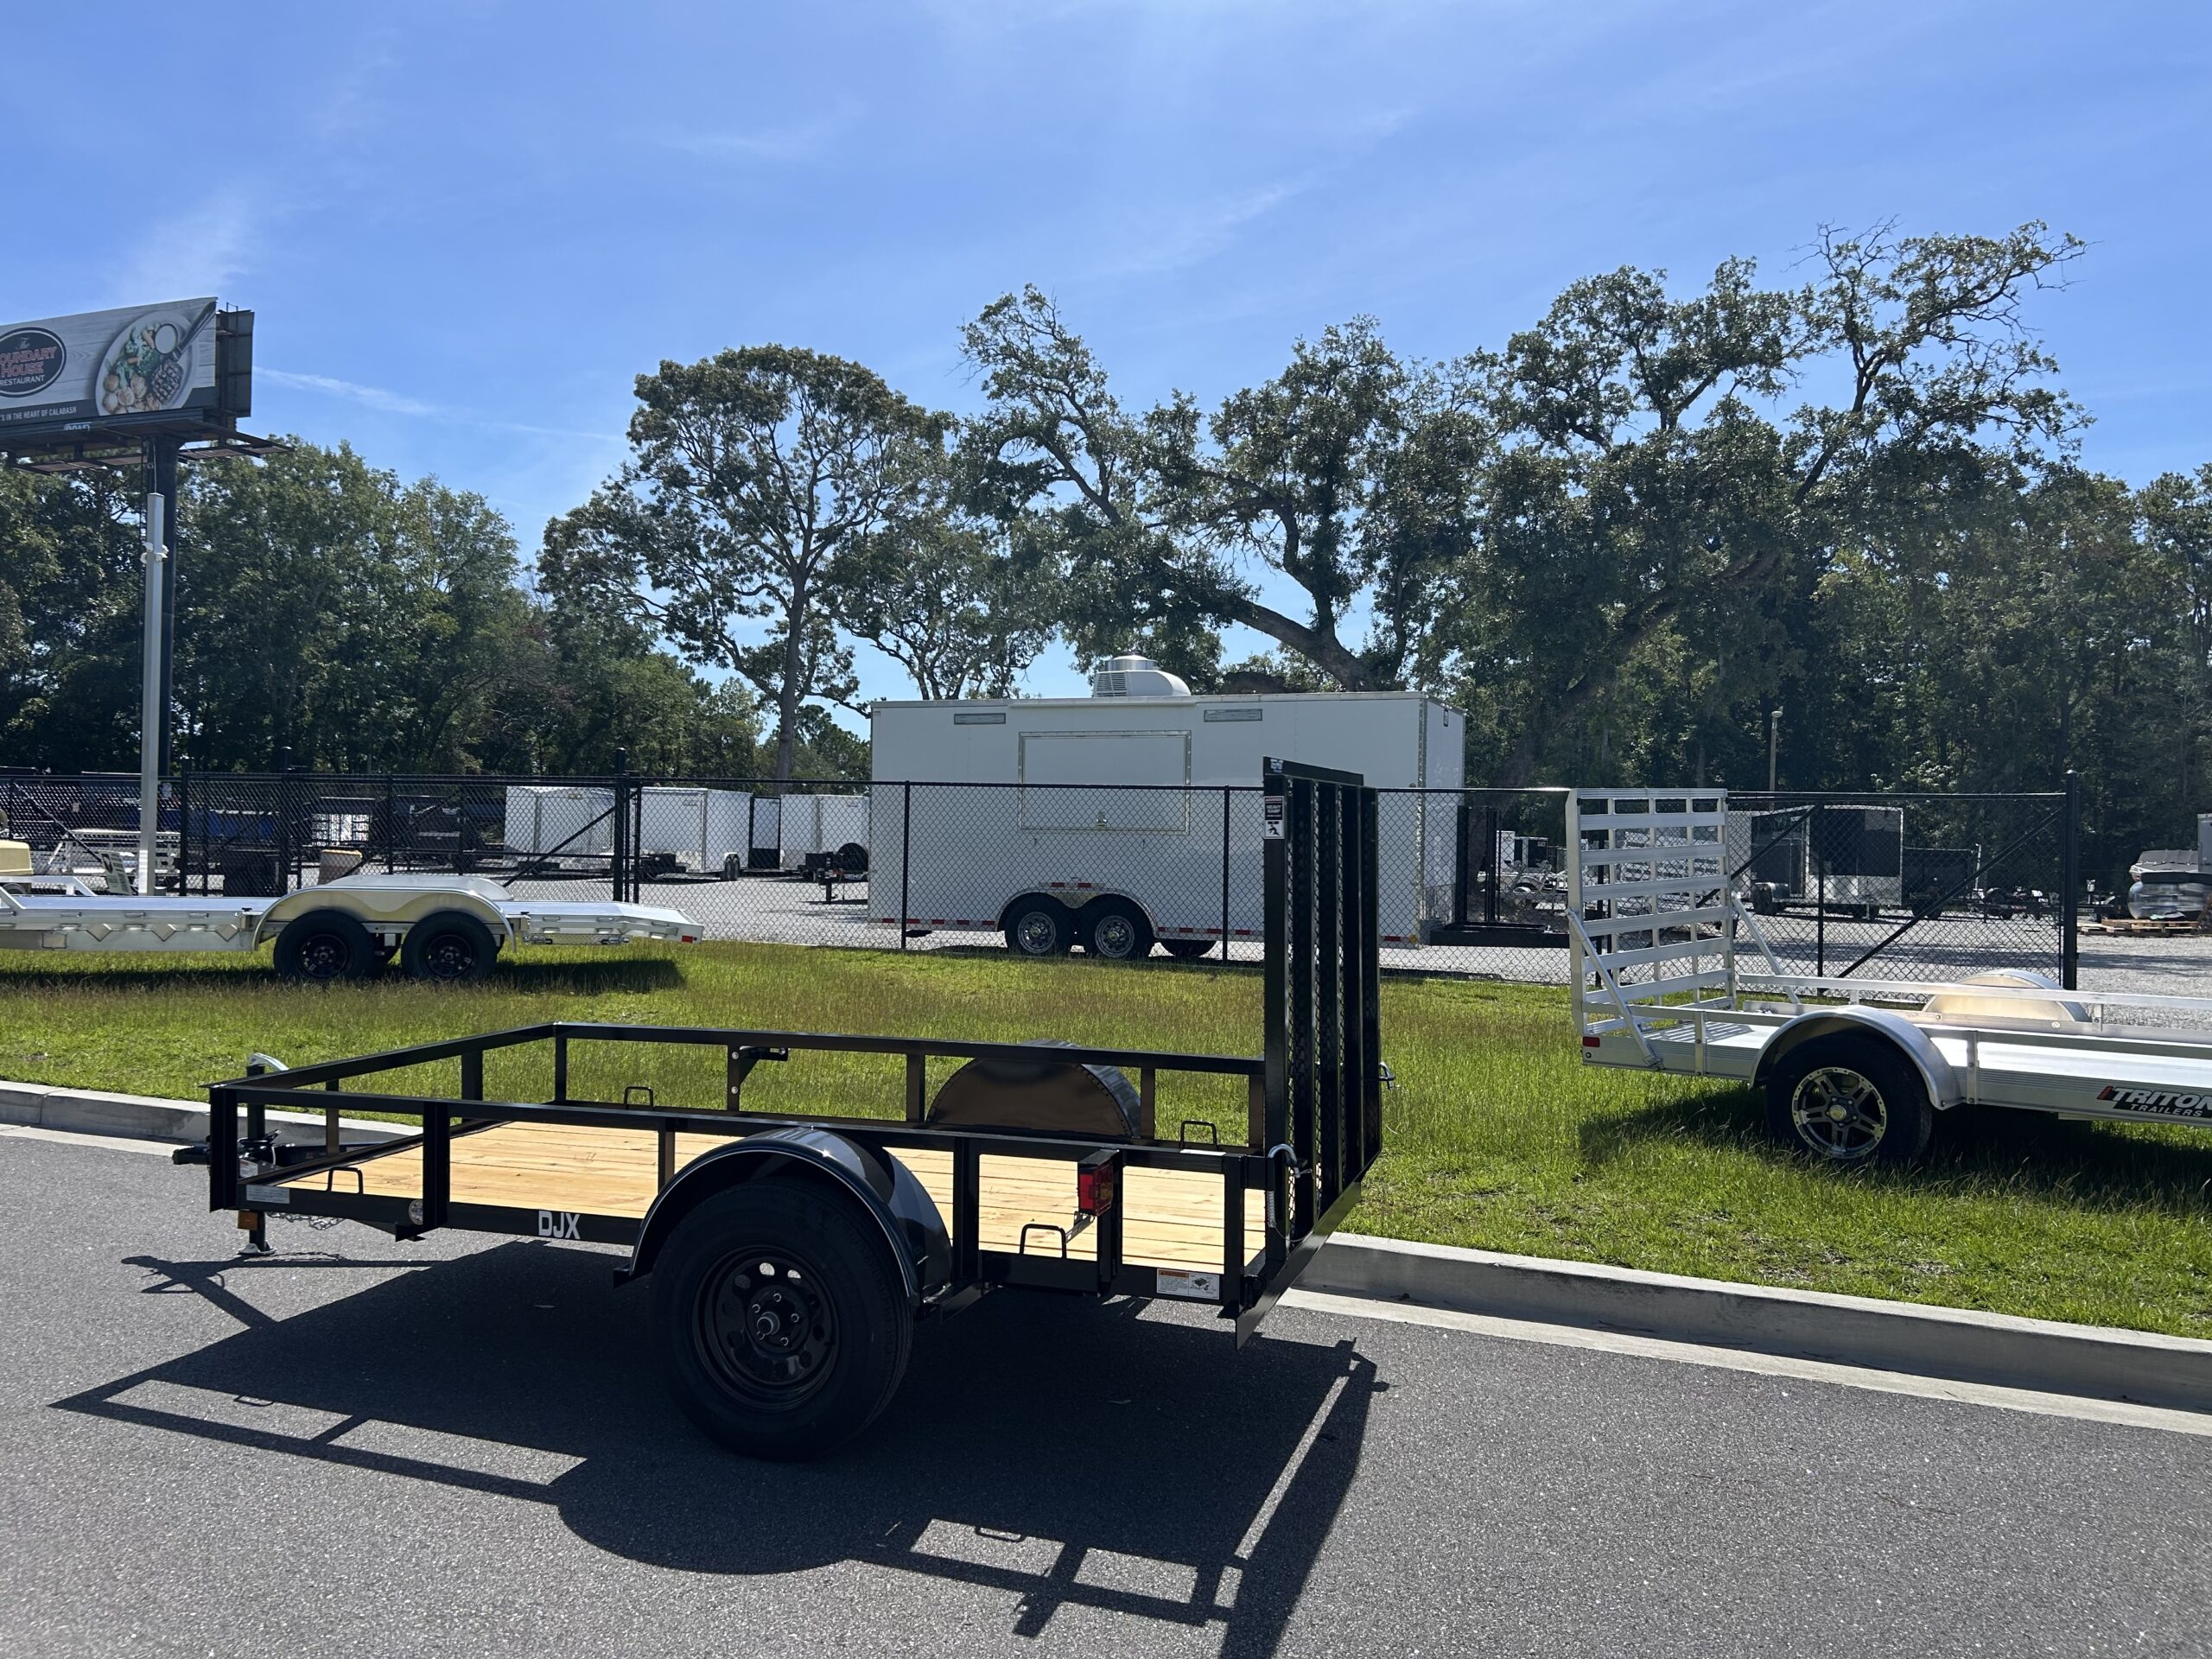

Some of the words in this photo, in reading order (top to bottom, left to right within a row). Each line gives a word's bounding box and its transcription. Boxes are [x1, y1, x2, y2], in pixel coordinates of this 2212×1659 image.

[0, 346, 57, 363] OUNDARY
[1, 361, 44, 378] HOUSE
[23, 410, 40, 419] HEART
[41, 409, 48, 417] OF
[49, 406, 77, 416] CALABASH
[2130, 1103, 2203, 1117] TRAILERS
[538, 1210, 582, 1240] DJX
